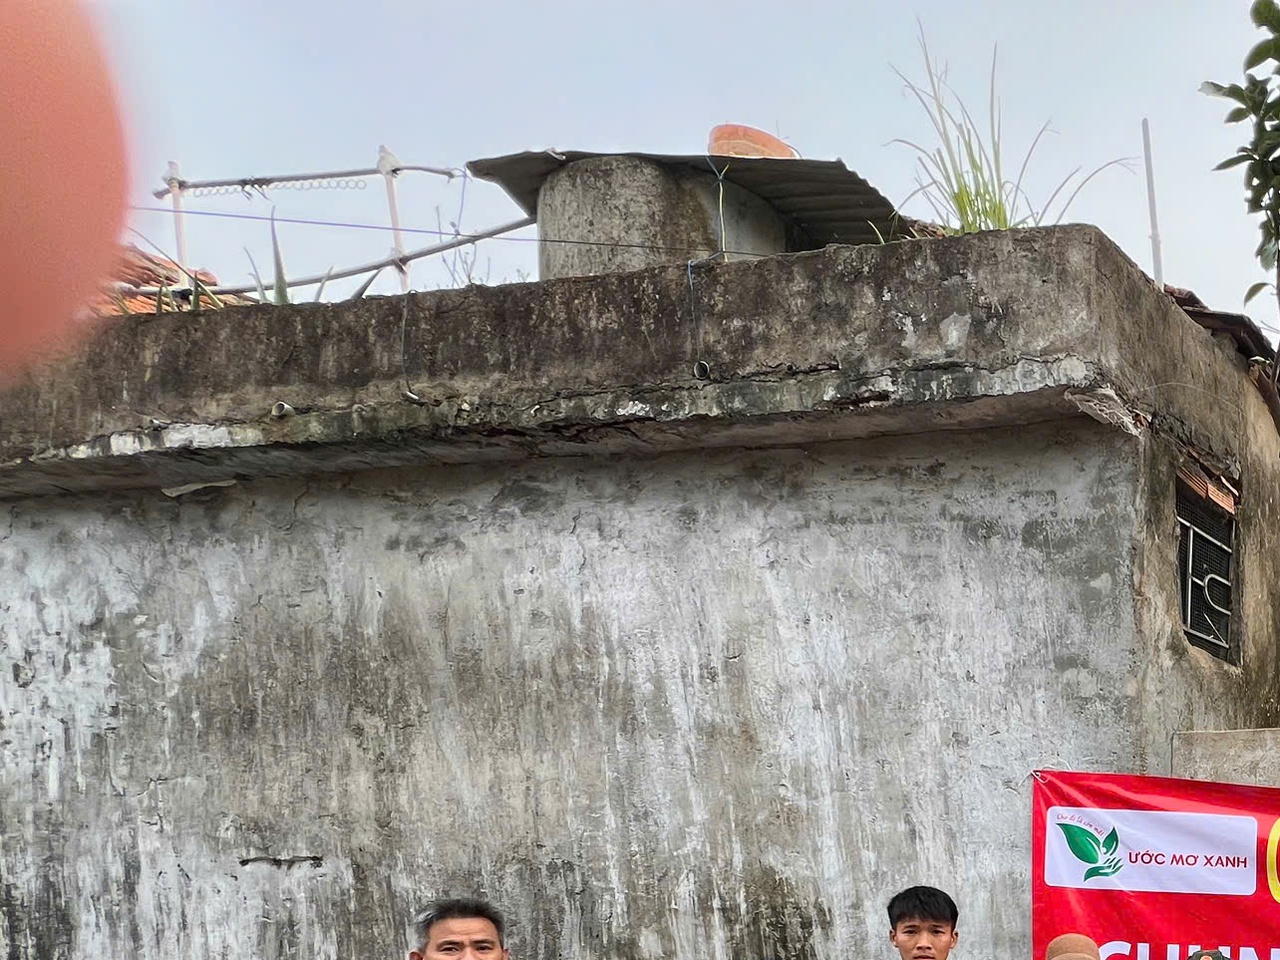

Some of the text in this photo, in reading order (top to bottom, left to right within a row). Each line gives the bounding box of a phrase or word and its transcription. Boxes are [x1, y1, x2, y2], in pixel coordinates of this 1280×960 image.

[1128, 850, 1248, 869] ƯỚC MƠ XANH
